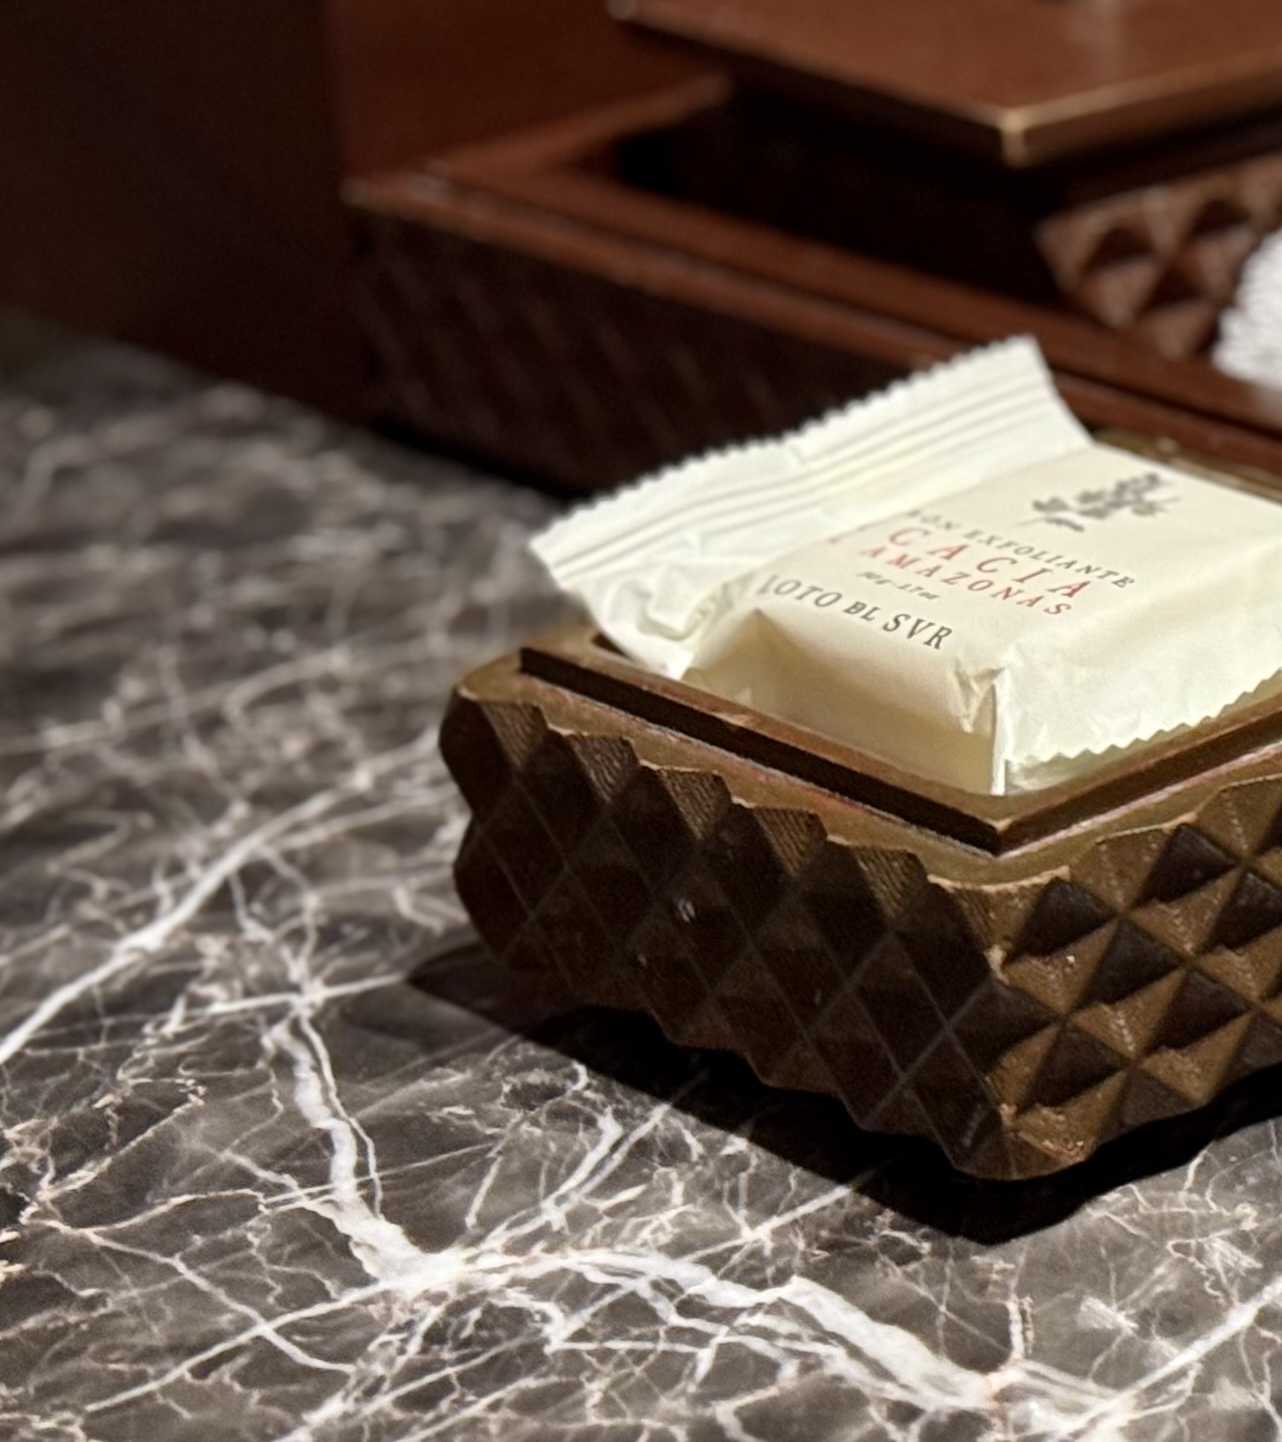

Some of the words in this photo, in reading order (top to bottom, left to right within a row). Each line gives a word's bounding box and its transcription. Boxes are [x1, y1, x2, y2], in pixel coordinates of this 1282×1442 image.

[860, 546, 1072, 615] AMAZONAS
[888, 526, 1091, 599] CACIA
[963, 529, 1135, 588] EXFOLIANTE
[882, 613, 953, 650] SVR
